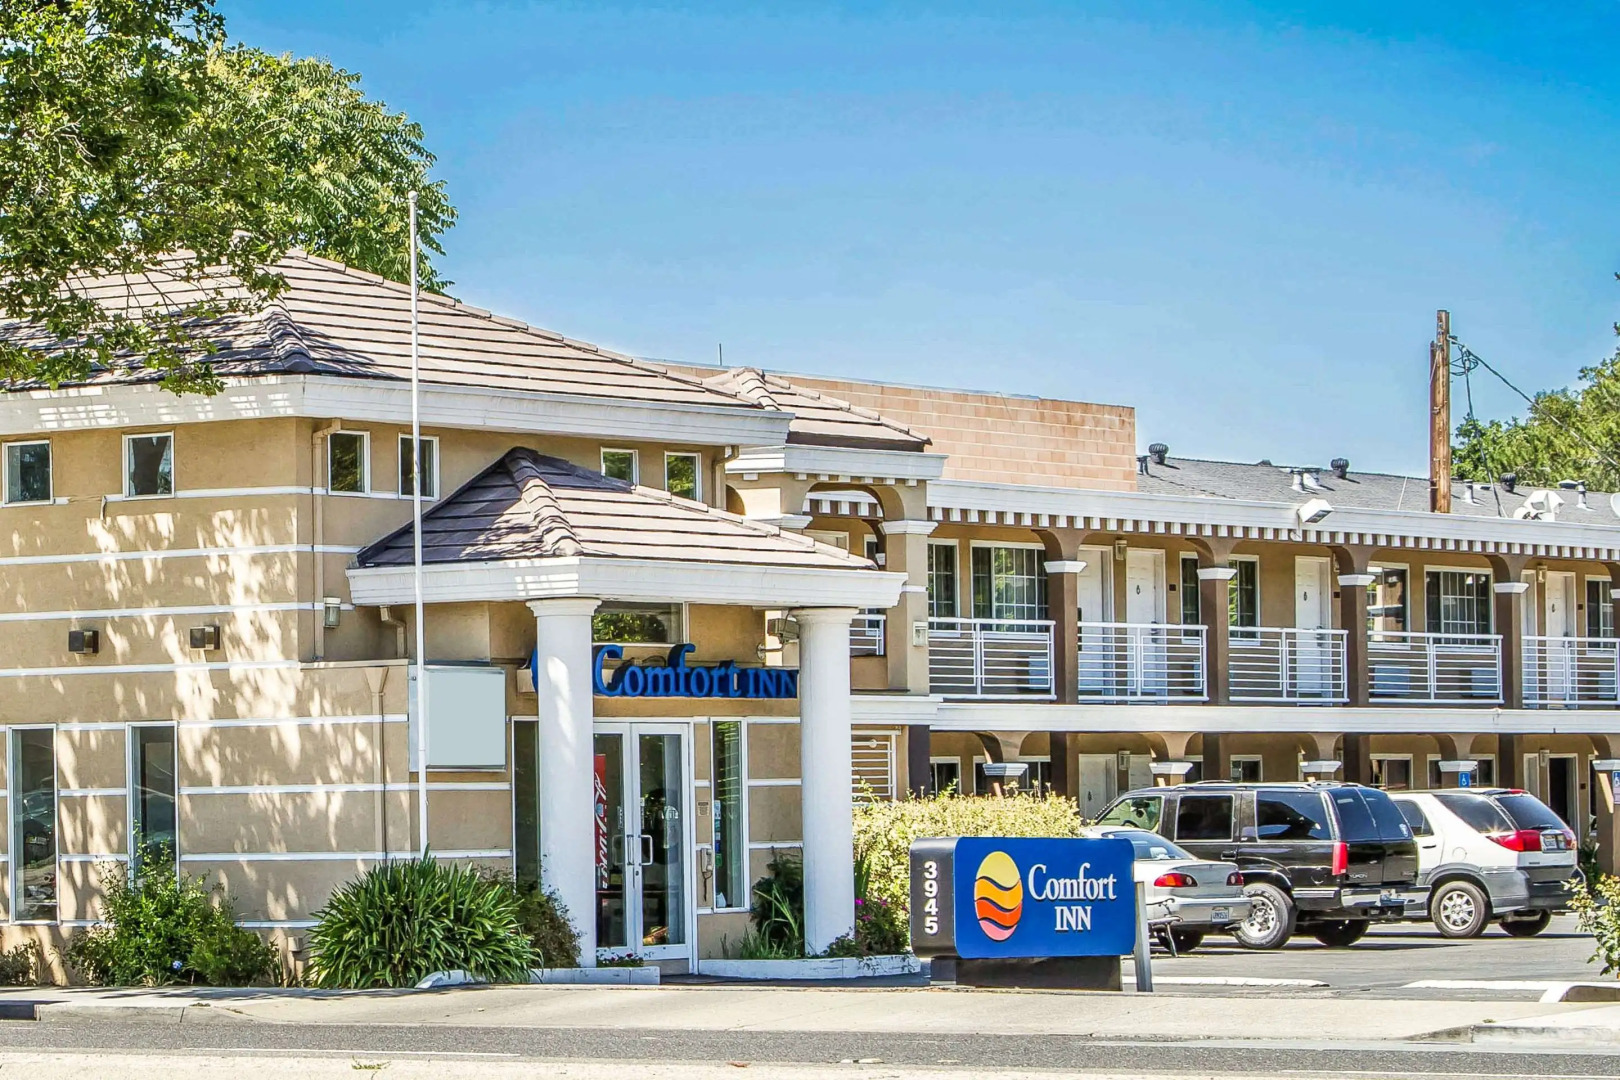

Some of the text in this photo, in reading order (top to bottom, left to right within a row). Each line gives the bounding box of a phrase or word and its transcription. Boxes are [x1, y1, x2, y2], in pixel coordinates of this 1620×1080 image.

[593, 643, 798, 698] Comfort INN
[923, 860, 939, 935] 3945
[1028, 862, 1117, 901] Comfort
[1054, 905, 1092, 931] INN
